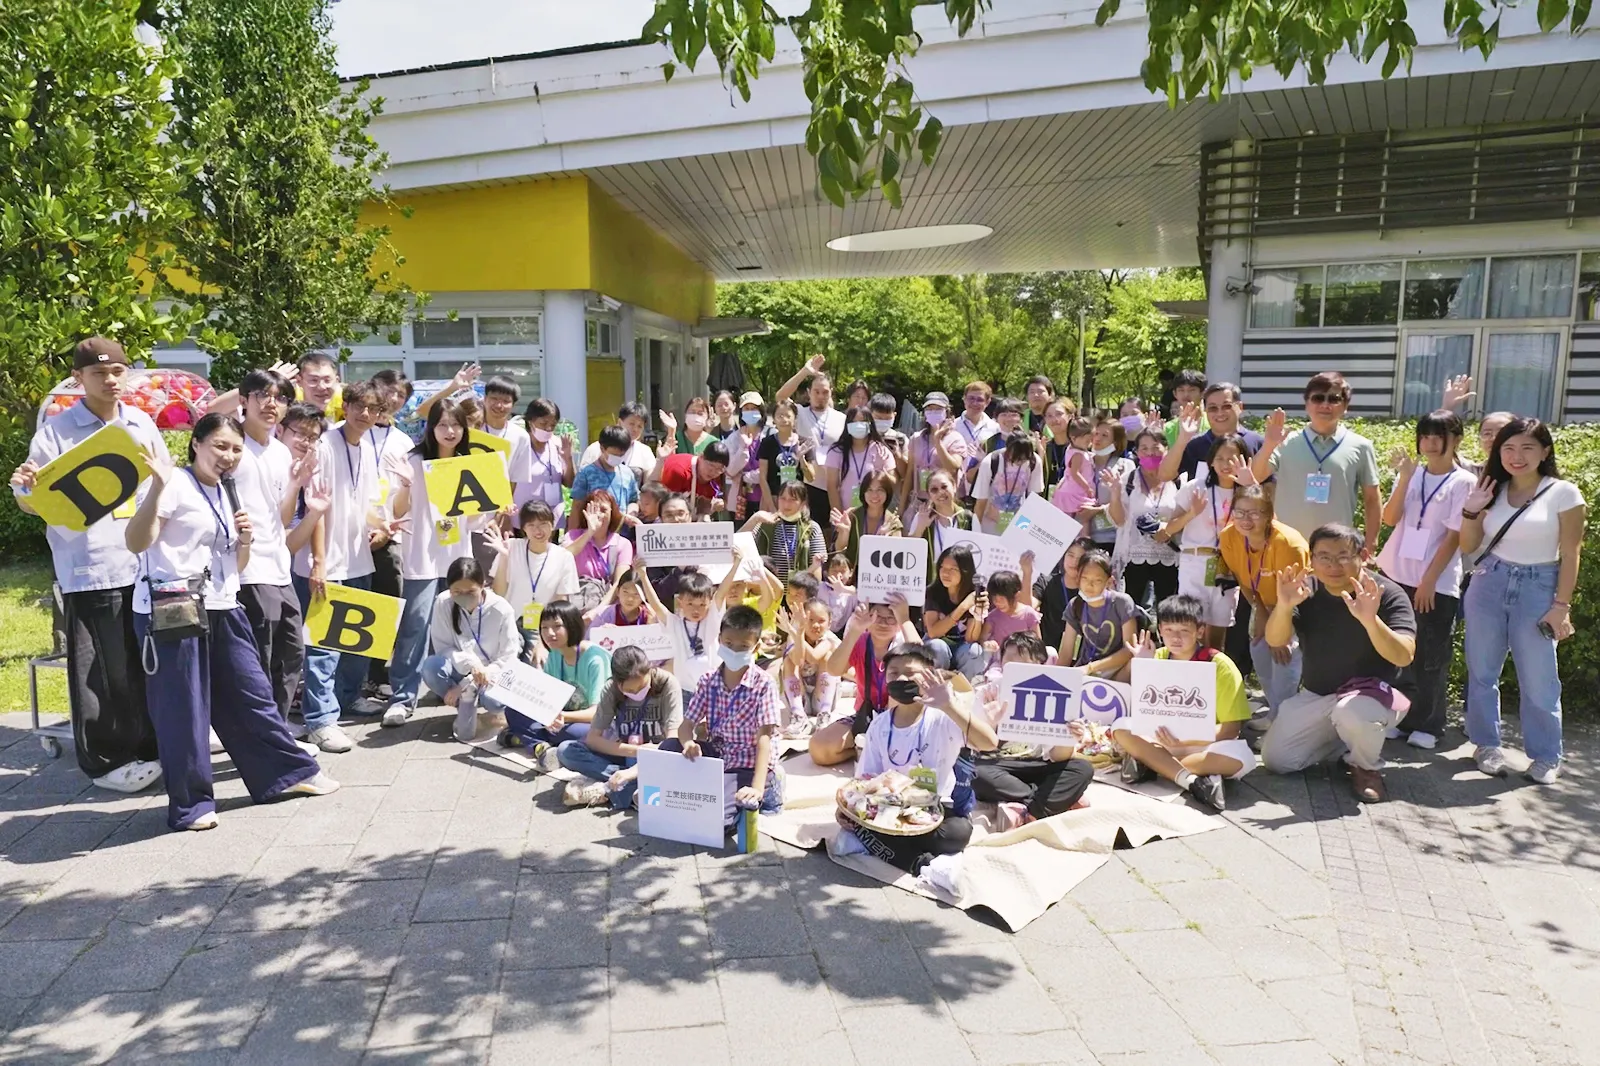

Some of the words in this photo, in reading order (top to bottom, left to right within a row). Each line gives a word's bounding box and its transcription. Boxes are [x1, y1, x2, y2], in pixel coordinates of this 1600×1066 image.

[49, 453, 139, 527] D
[445, 469, 500, 516] A
[318, 600, 376, 652] B
[665, 790, 717, 804] 工業技術研究院
